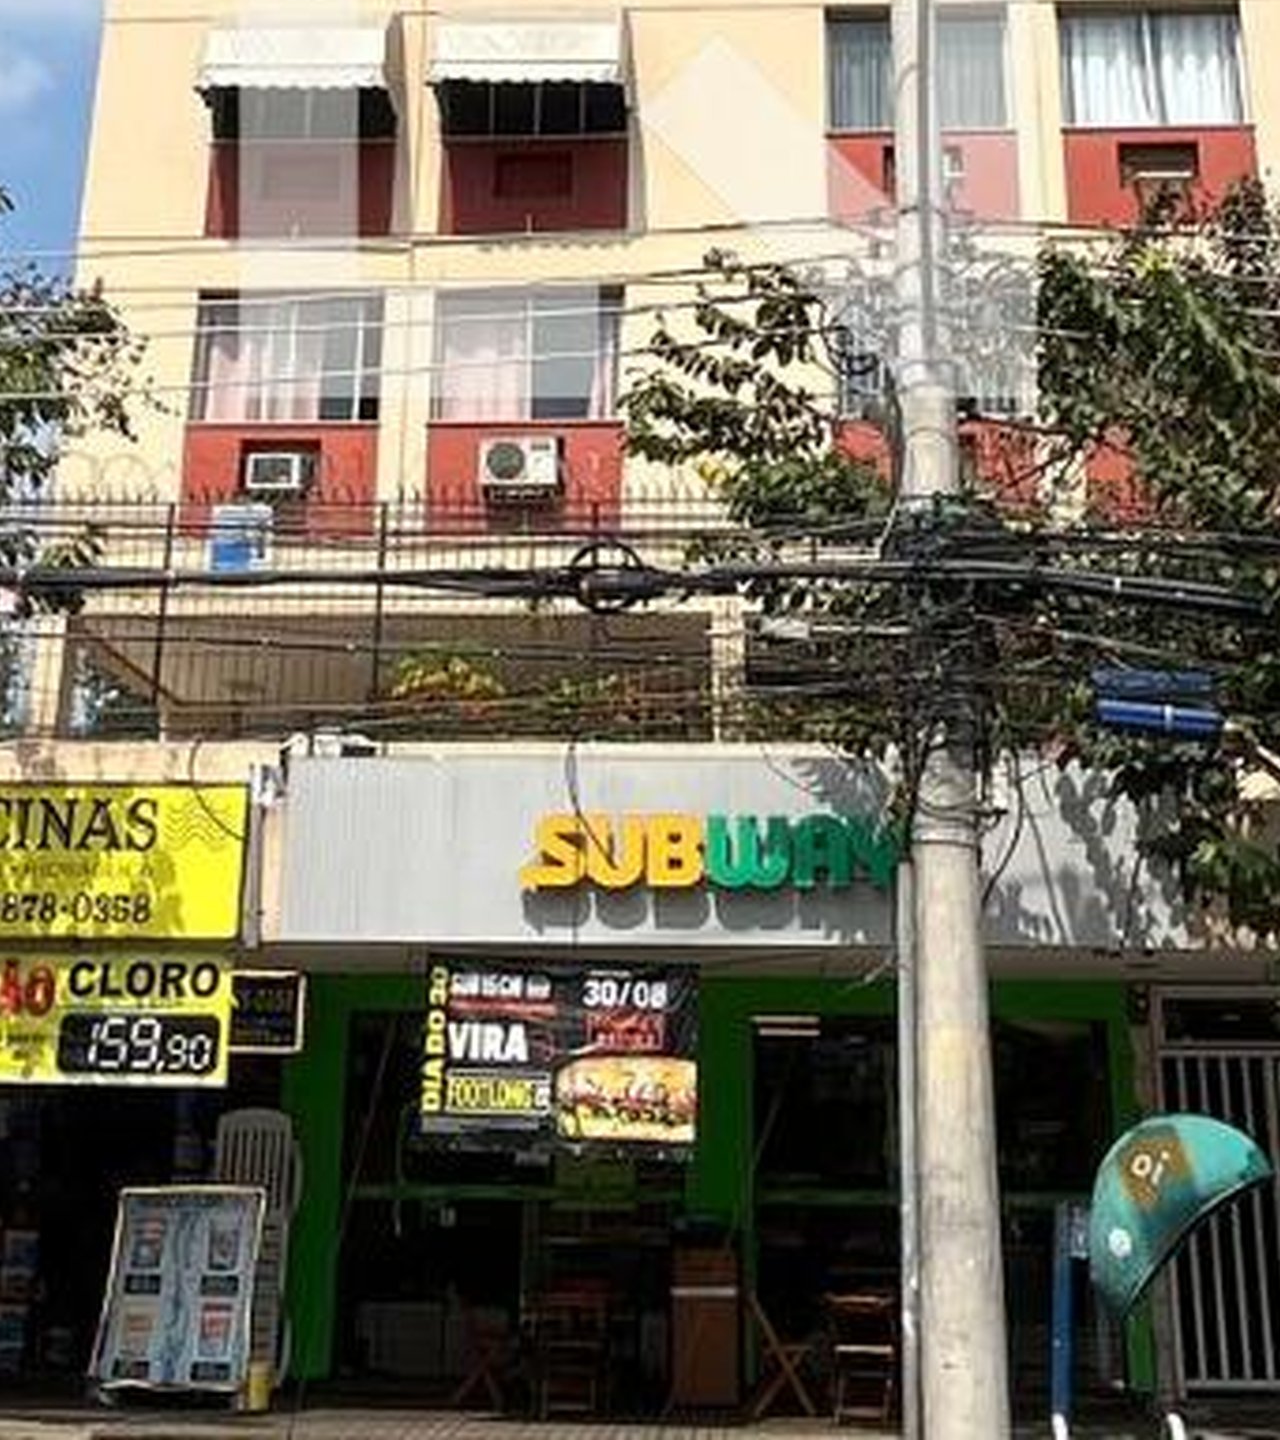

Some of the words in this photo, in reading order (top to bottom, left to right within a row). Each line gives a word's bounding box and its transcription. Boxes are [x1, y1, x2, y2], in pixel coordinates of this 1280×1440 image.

[69, 962, 220, 997] CLORO
[88, 1019, 212, 1071] 159,90
[449, 1022, 528, 1062] VIRA
